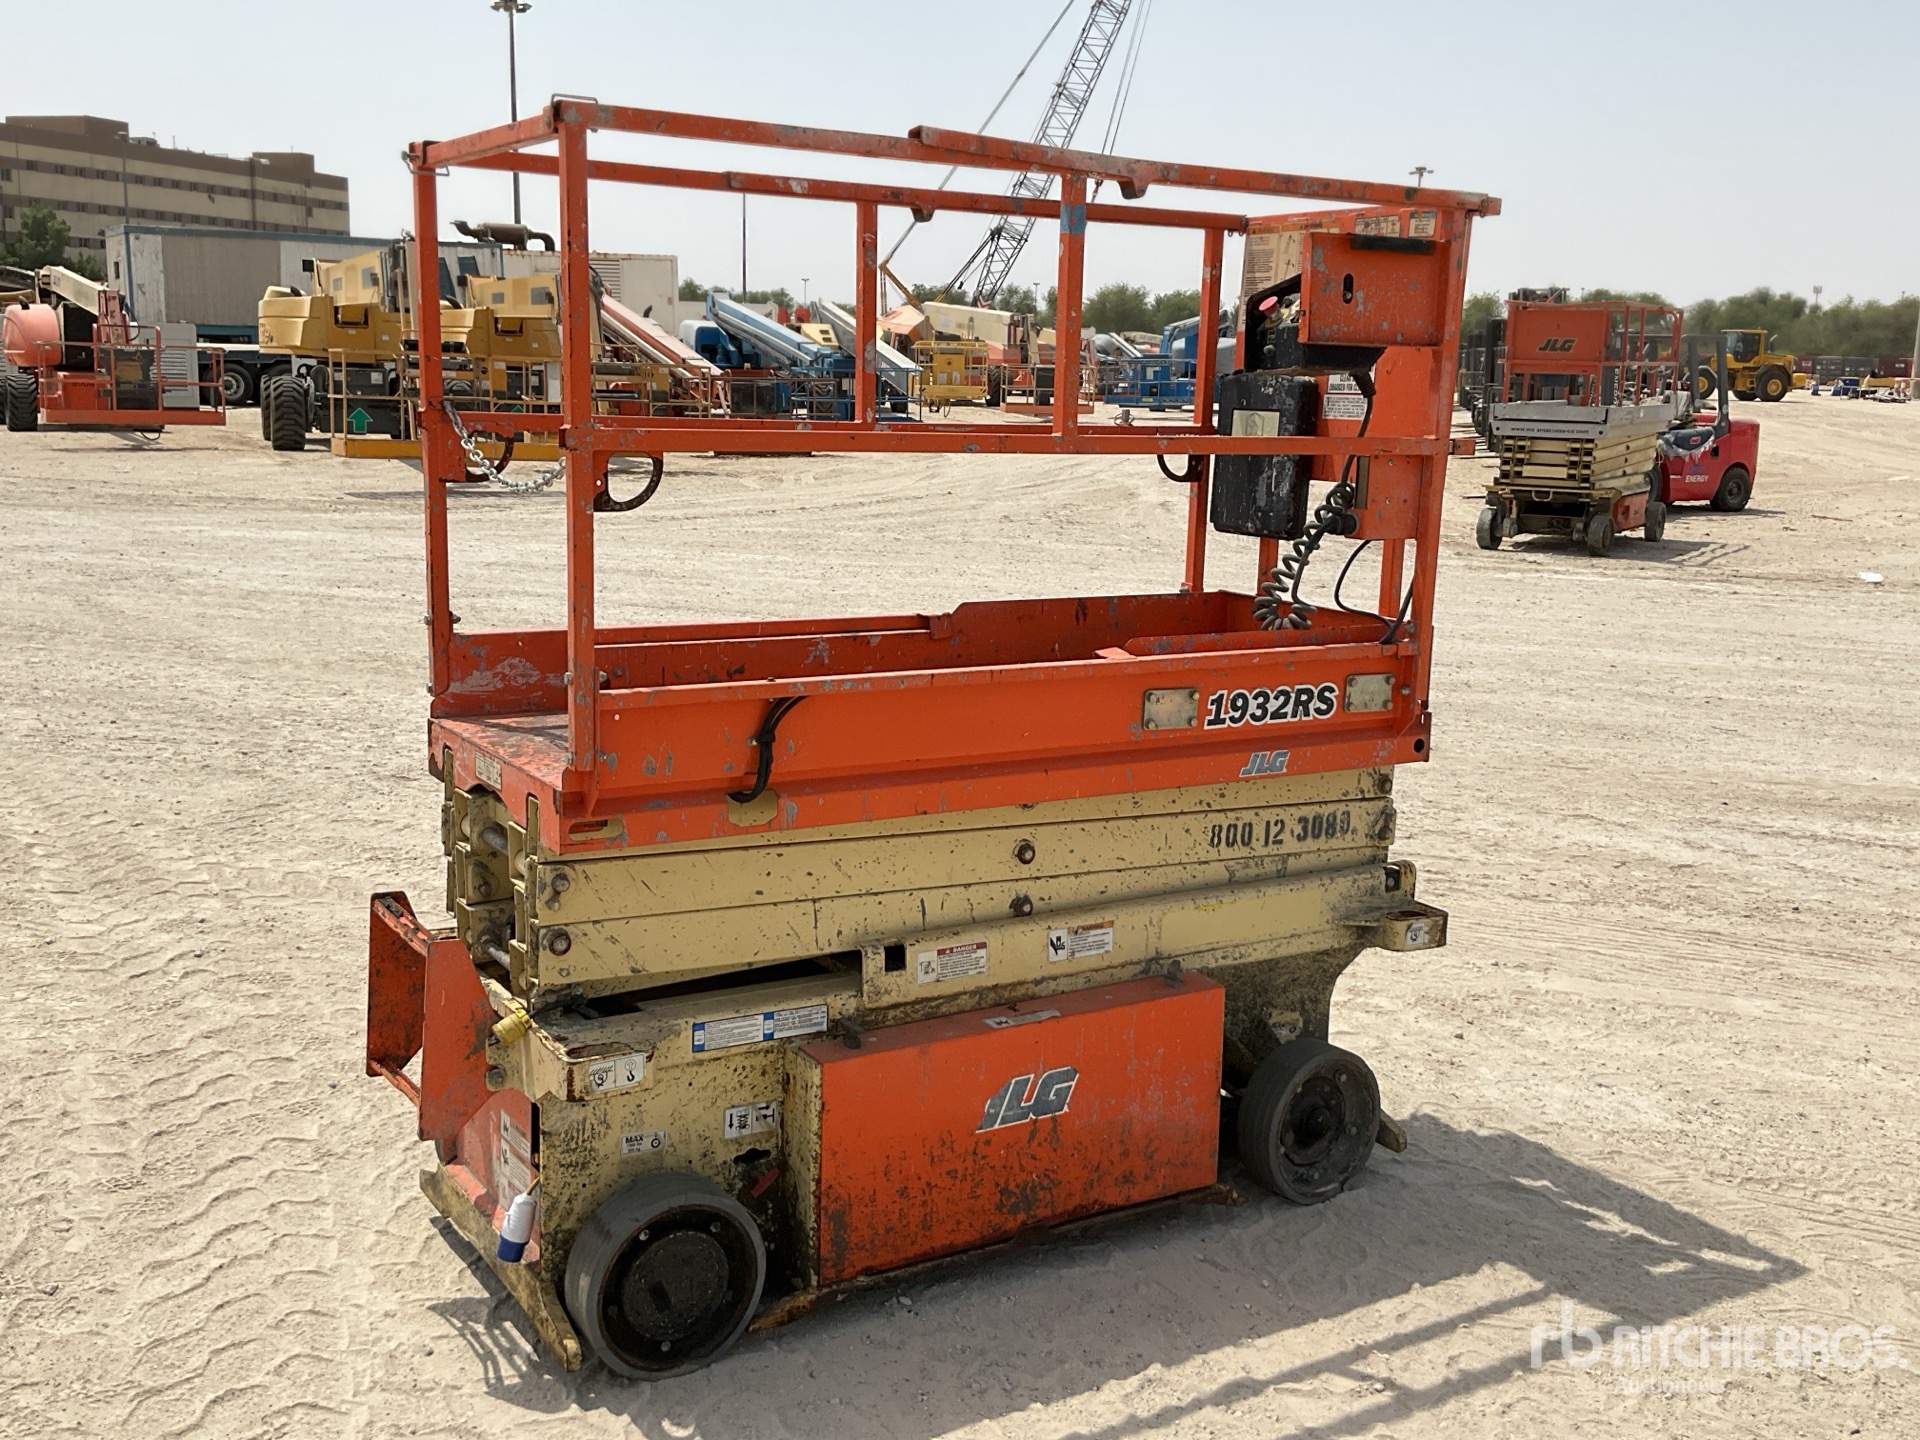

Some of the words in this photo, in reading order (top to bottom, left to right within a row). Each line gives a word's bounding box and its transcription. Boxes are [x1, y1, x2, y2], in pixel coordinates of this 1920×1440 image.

[1537, 337, 1577, 352] JLG
[1685, 474, 1709, 482] ENERGY
[1205, 684, 1338, 728] 1932RS
[1239, 750, 1290, 777] JLG
[1209, 822, 1253, 848] 800
[952, 944, 977, 953] DANGER
[976, 1066, 1079, 1133] JLG
[626, 1134, 644, 1144] MAX
